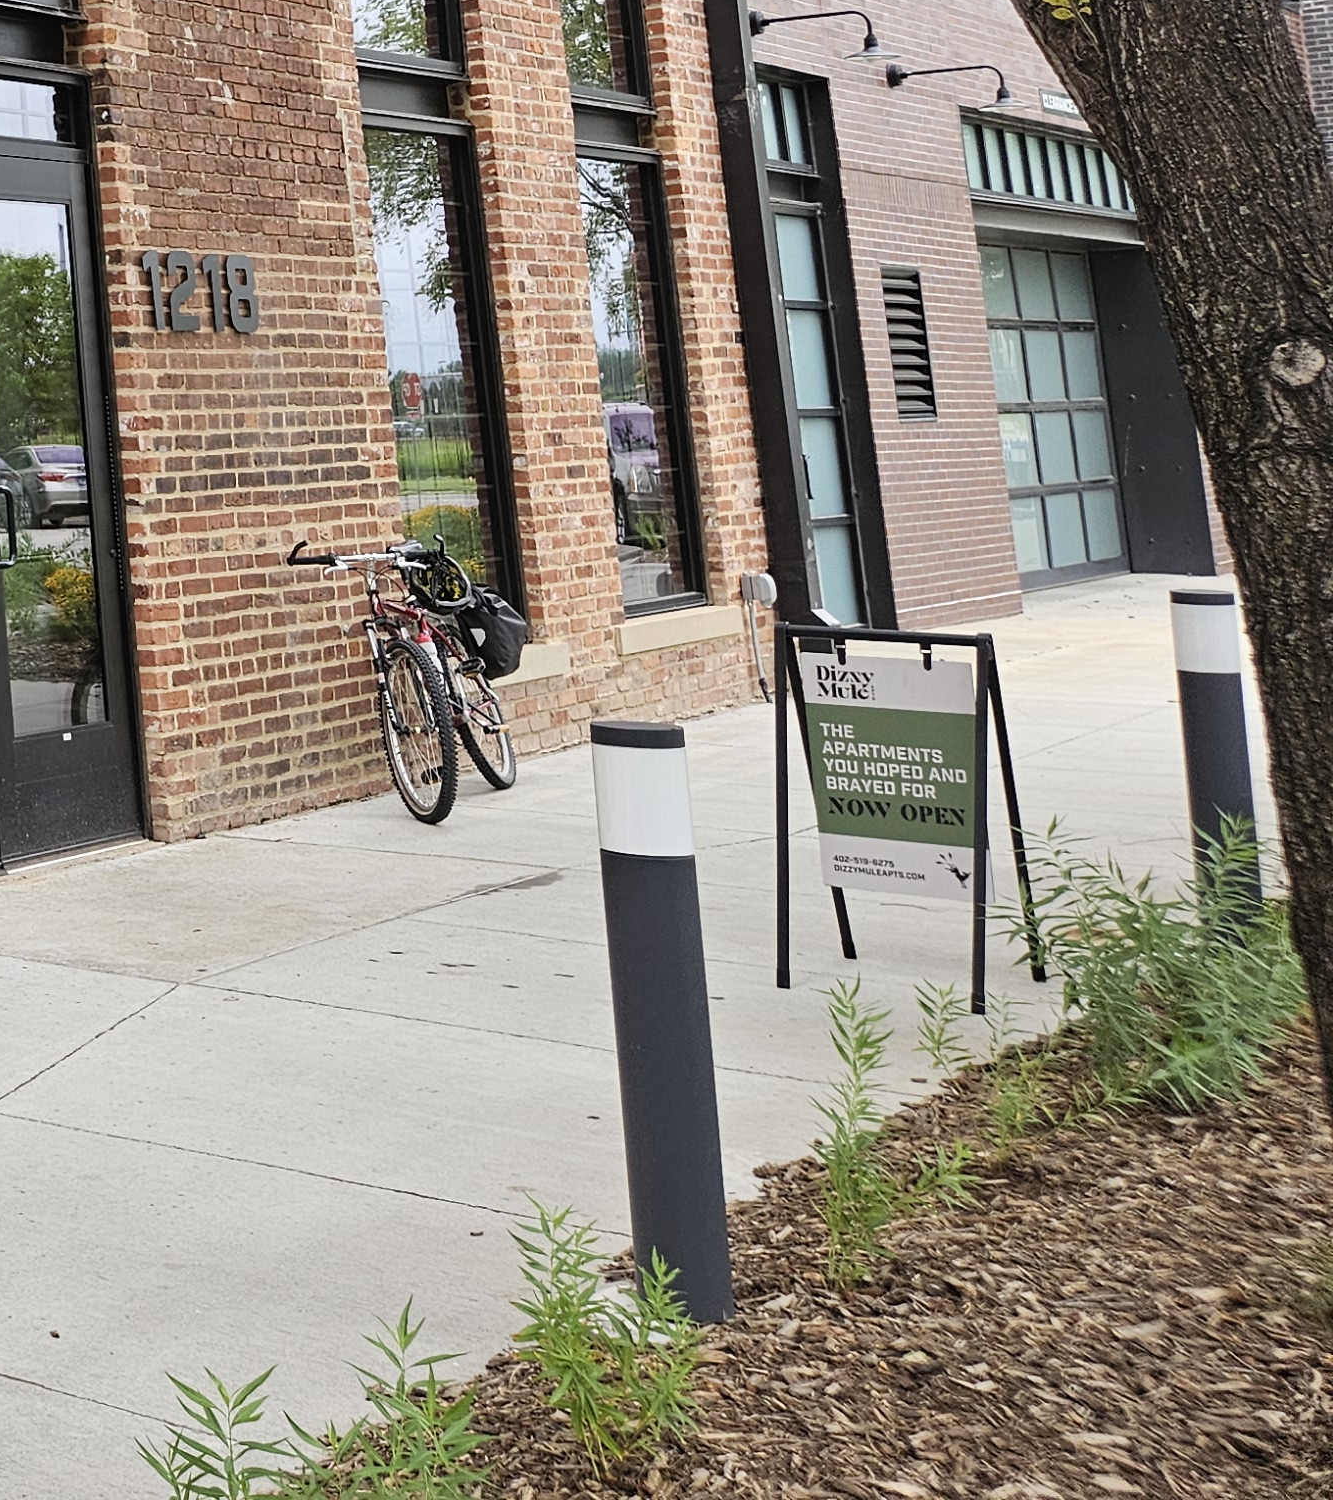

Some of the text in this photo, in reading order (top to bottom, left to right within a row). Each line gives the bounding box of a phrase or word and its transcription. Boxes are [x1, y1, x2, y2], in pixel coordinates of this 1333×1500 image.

[142, 250, 259, 333] 1218
[816, 664, 875, 688] Dizzy
[817, 681, 870, 700] Mule
[819, 722, 855, 739] THE
[822, 740, 944, 764] APARTMENTS
[823, 757, 968, 784] YOU HOPED AND
[825, 775, 937, 799] BRAYED FOR
[828, 796, 966, 826] NOW OPEN
[834, 864, 926, 881] DIZZYMULEAPTS.COM
